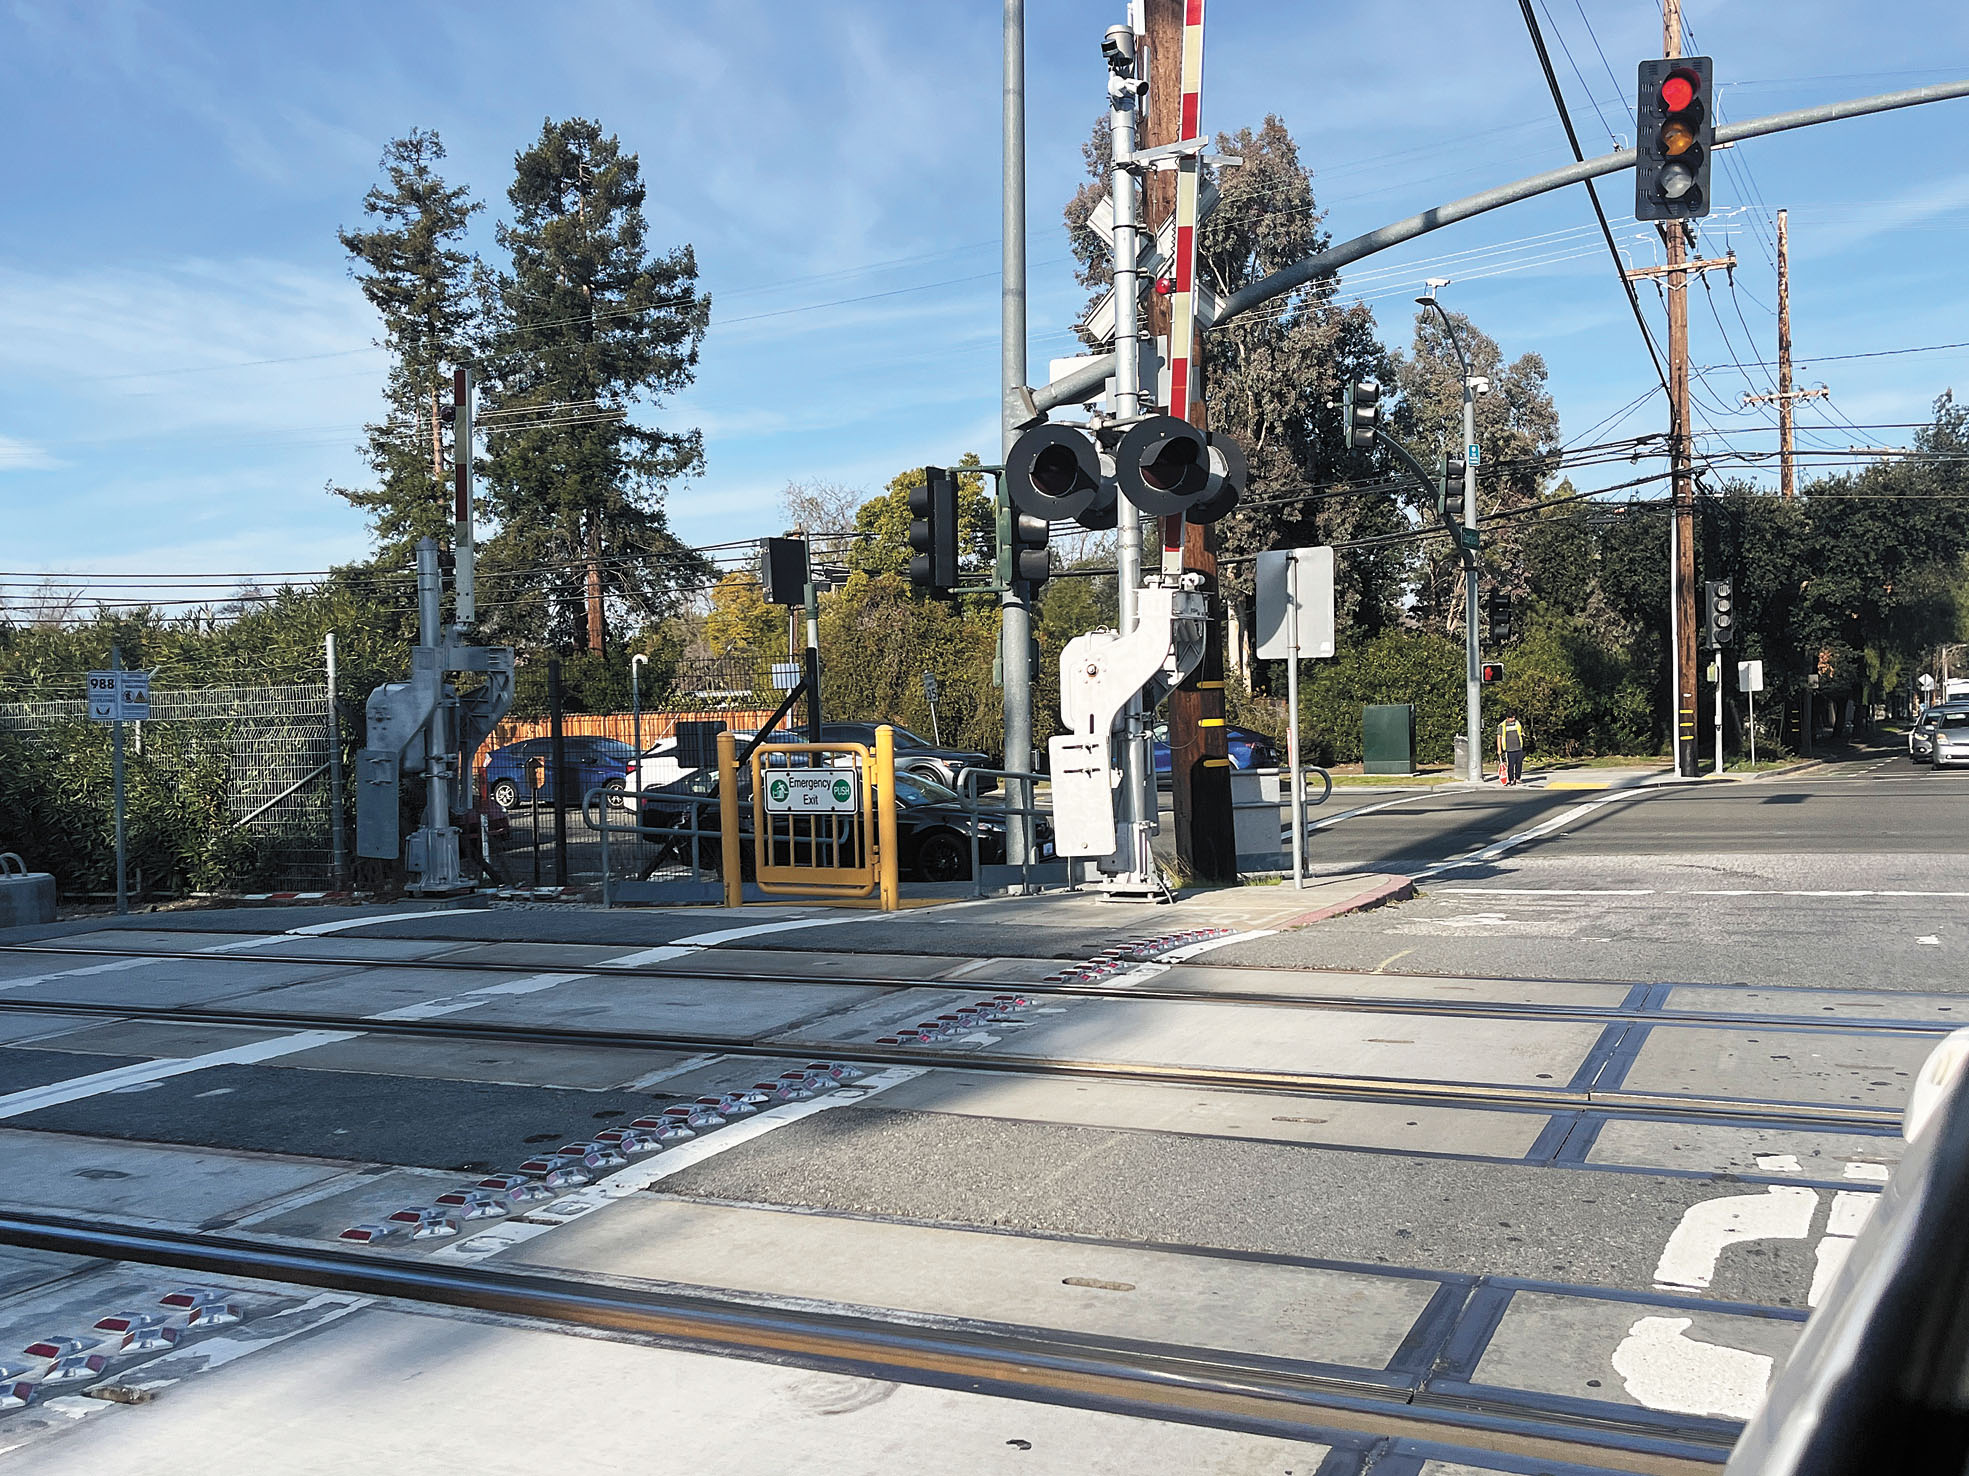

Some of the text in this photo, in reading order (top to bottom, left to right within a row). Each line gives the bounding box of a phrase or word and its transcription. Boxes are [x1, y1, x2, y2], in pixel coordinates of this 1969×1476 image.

[90, 678, 115, 689] 988
[927, 688, 937, 700] 35
[788, 777, 831, 790] Emergency
[833, 786, 850, 796] PUSH
[803, 794, 819, 806] Exit
